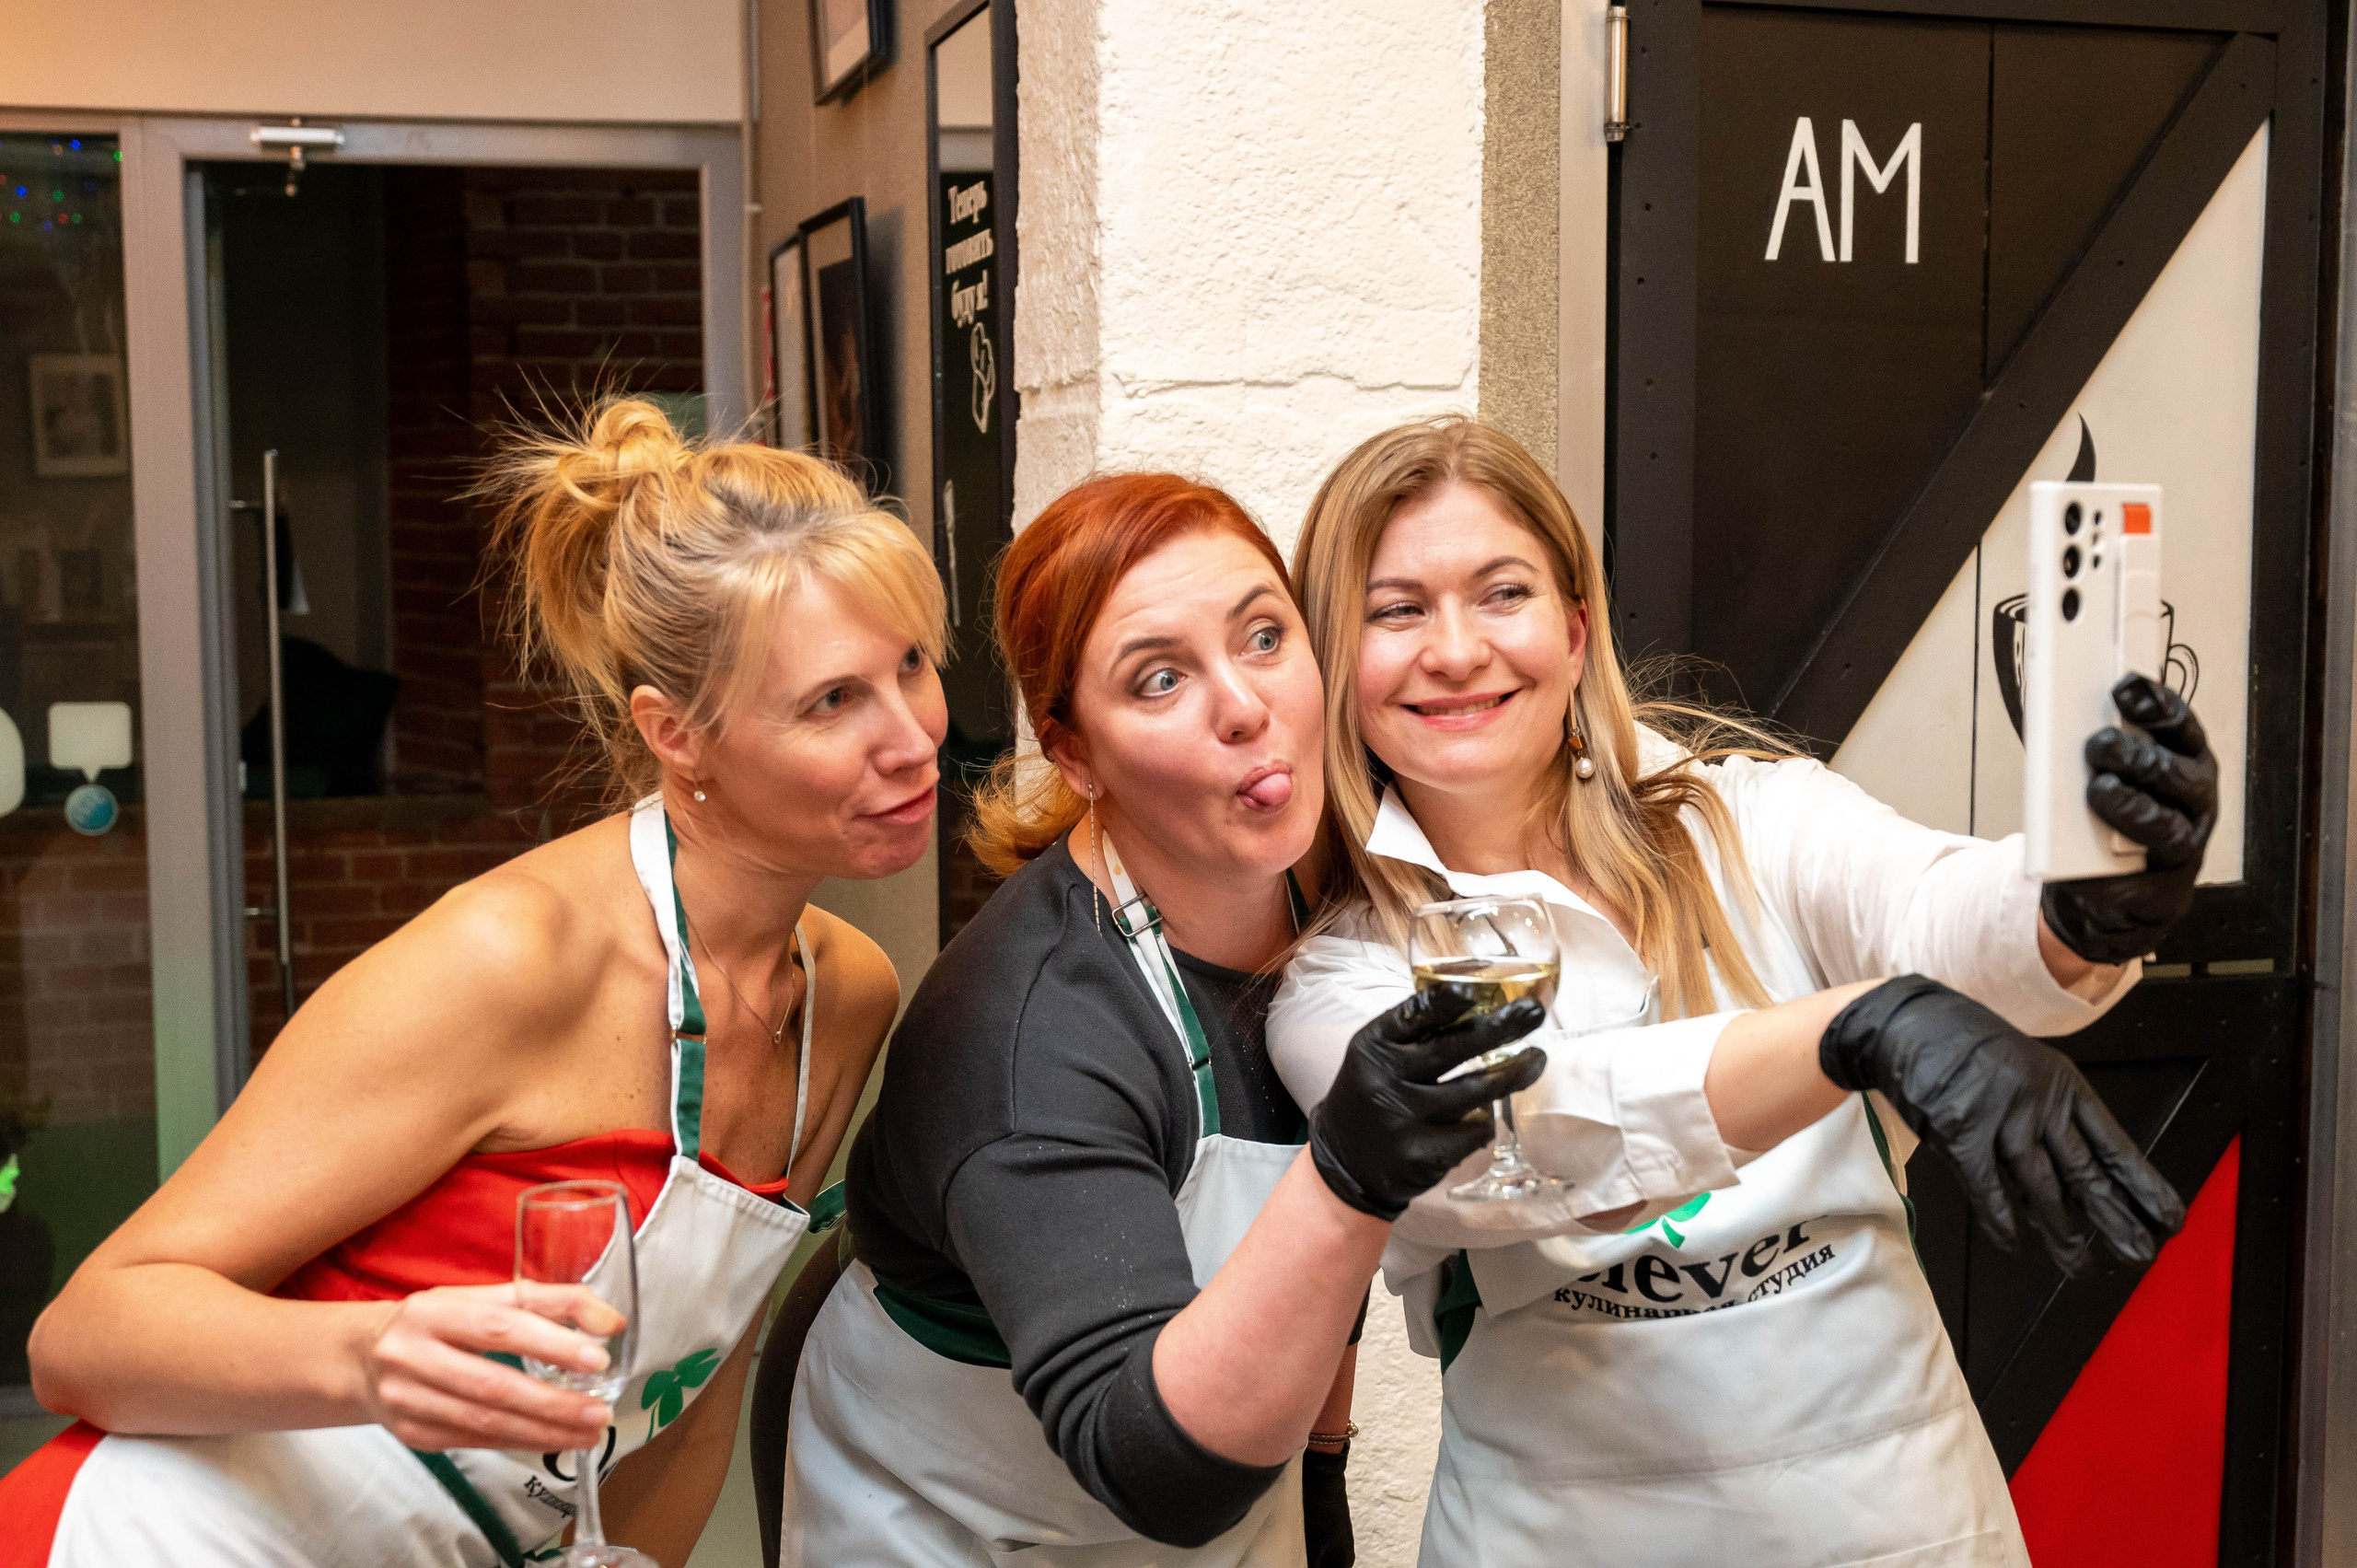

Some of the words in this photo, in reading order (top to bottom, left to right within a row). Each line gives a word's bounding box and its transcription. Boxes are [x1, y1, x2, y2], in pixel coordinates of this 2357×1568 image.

[1764, 116, 1922, 263] AM
[1577, 1214, 1829, 1304] lever
[1747, 1243, 1836, 1303] студия
